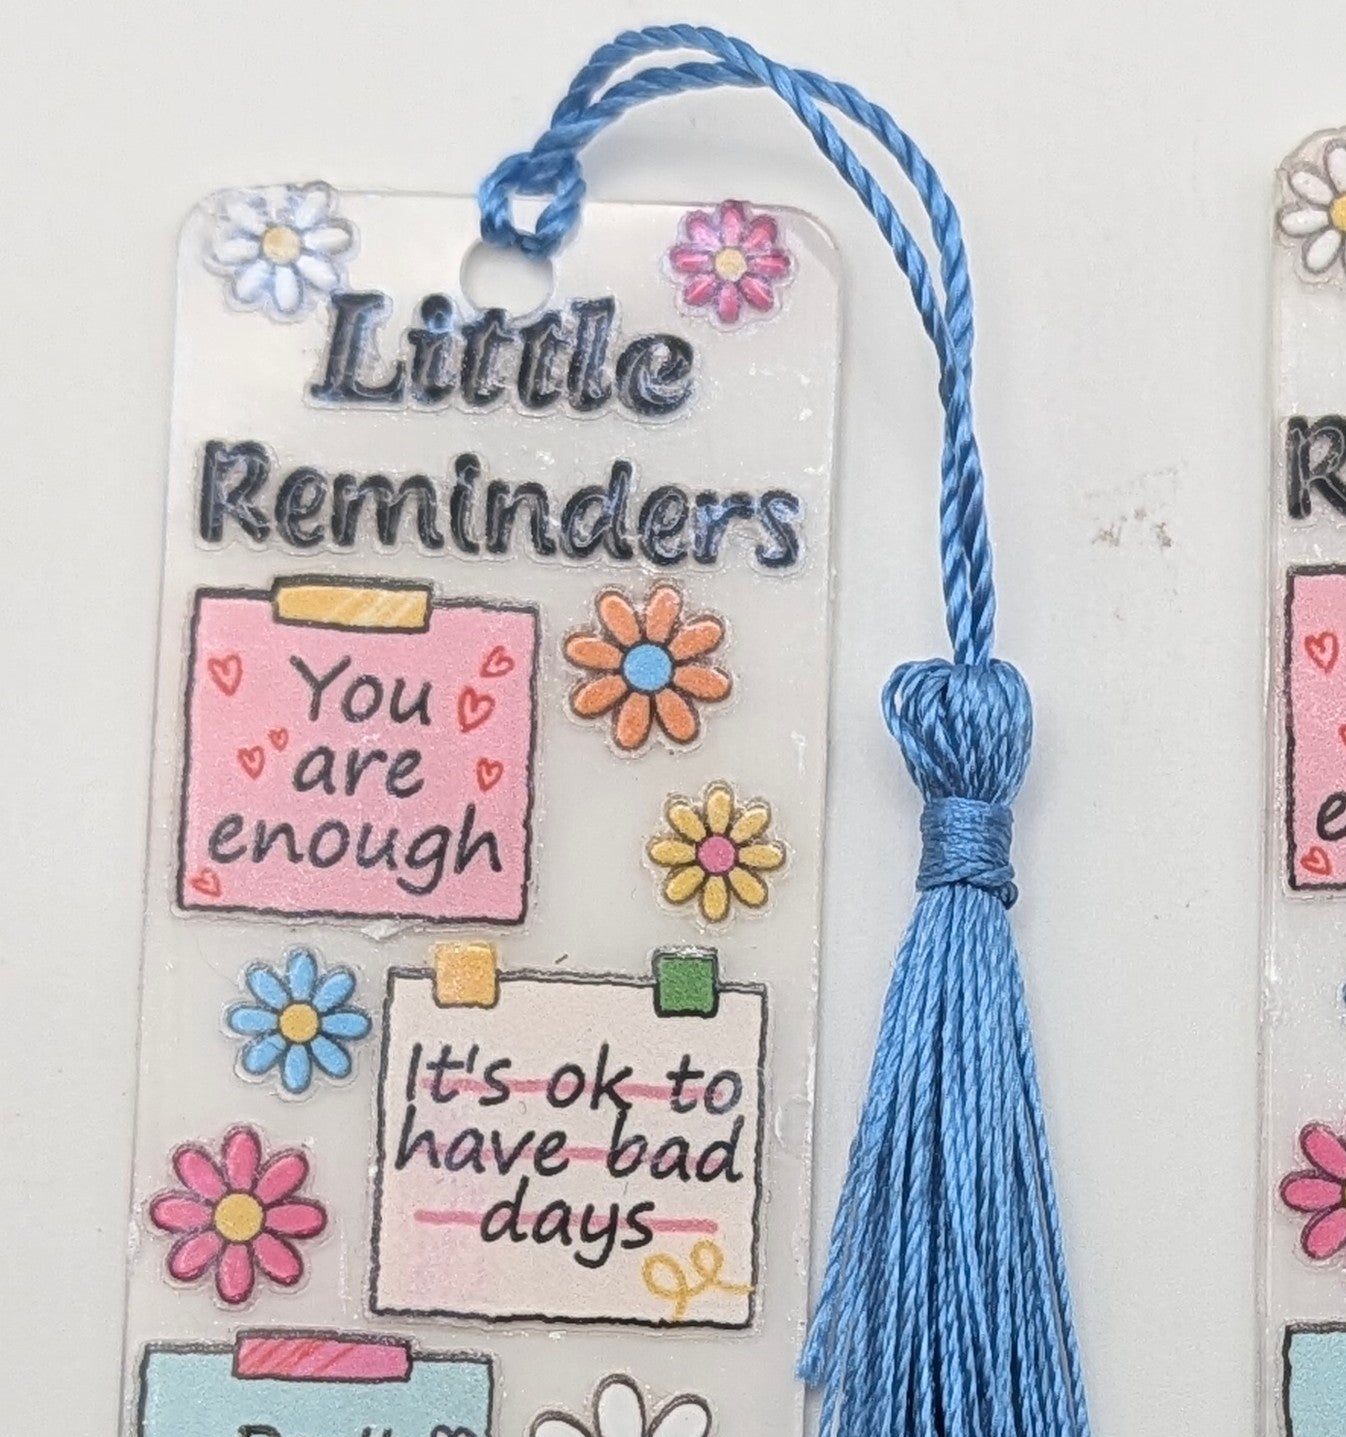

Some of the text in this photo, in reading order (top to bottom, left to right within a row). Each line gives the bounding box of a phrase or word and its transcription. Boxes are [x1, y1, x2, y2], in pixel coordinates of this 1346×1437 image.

[310, 293, 695, 416] Little
[203, 440, 802, 567] Reminders
[290, 654, 432, 726] You
[291, 742, 425, 798] are
[208, 804, 503, 895] enough
[405, 1043, 743, 1116] It's ok to
[395, 1103, 744, 1183] have bad
[480, 1177, 655, 1268] days
